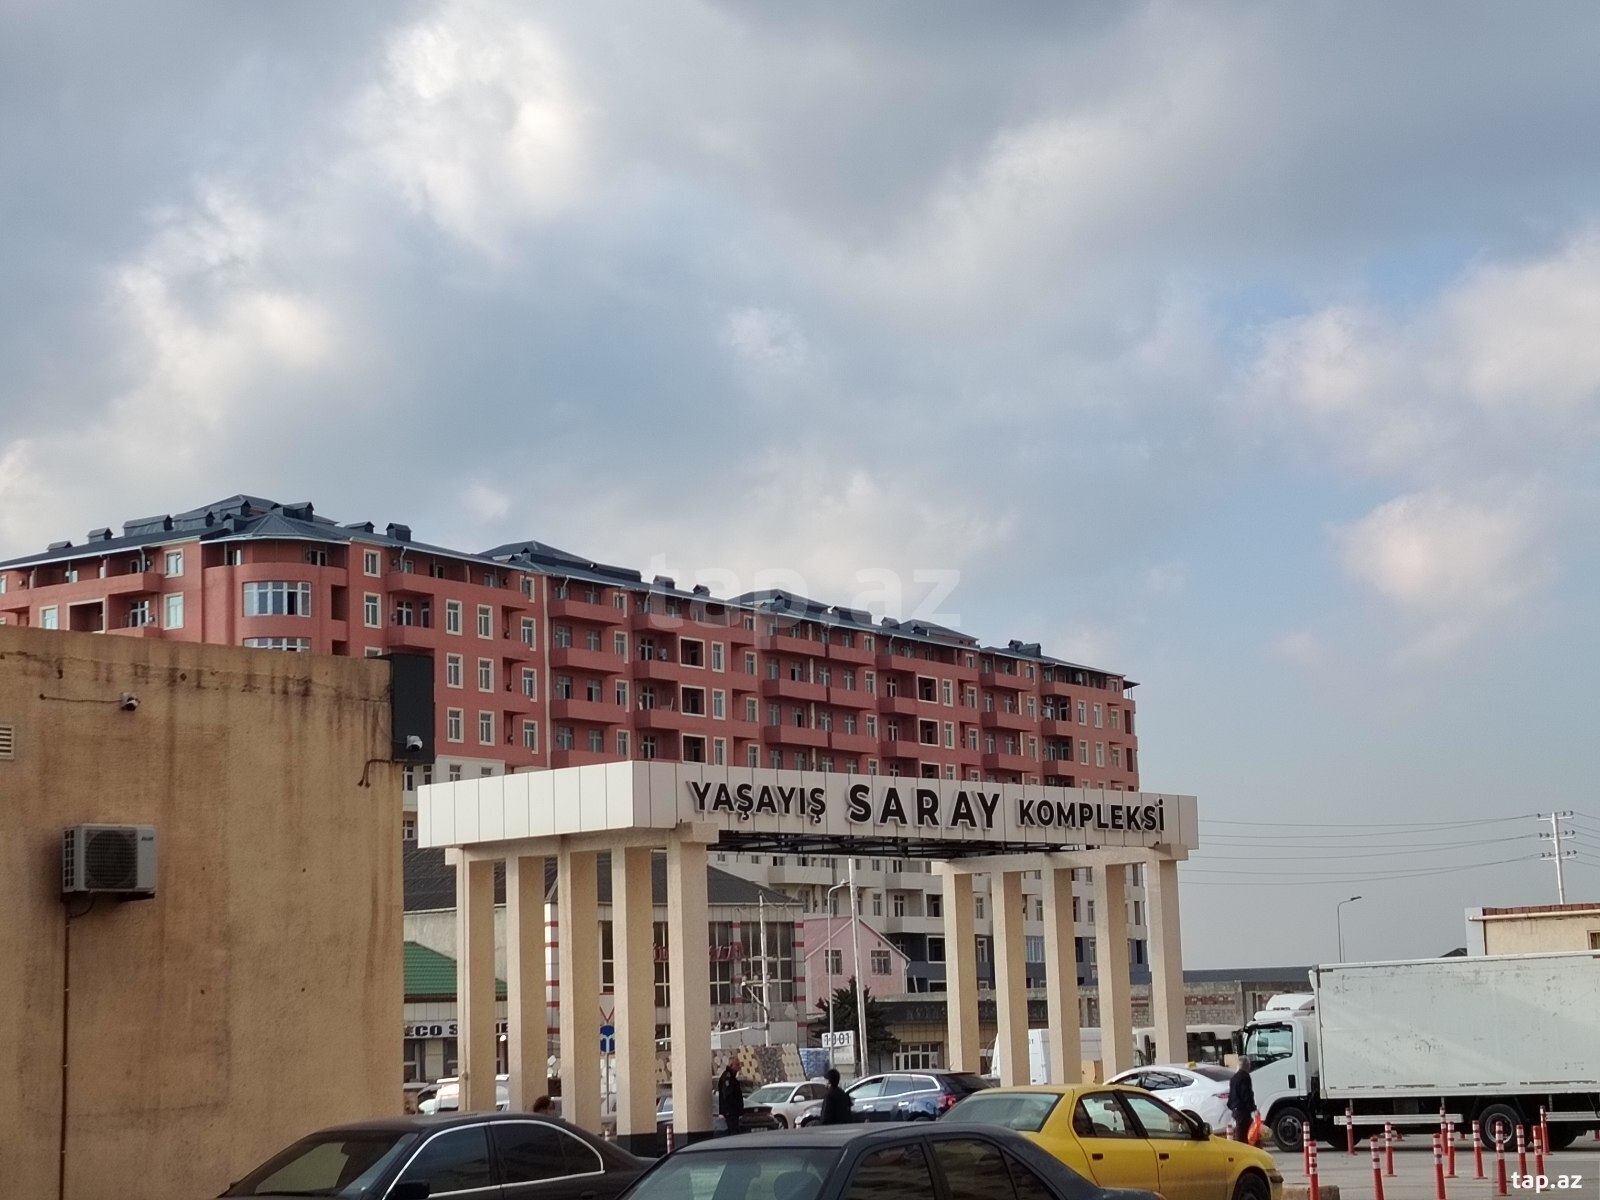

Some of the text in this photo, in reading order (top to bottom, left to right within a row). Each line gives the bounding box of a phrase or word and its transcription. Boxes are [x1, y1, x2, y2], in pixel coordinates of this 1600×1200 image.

[692, 782, 1164, 831] YAŞAYIŞ SARAY KOMPLEKSİ
